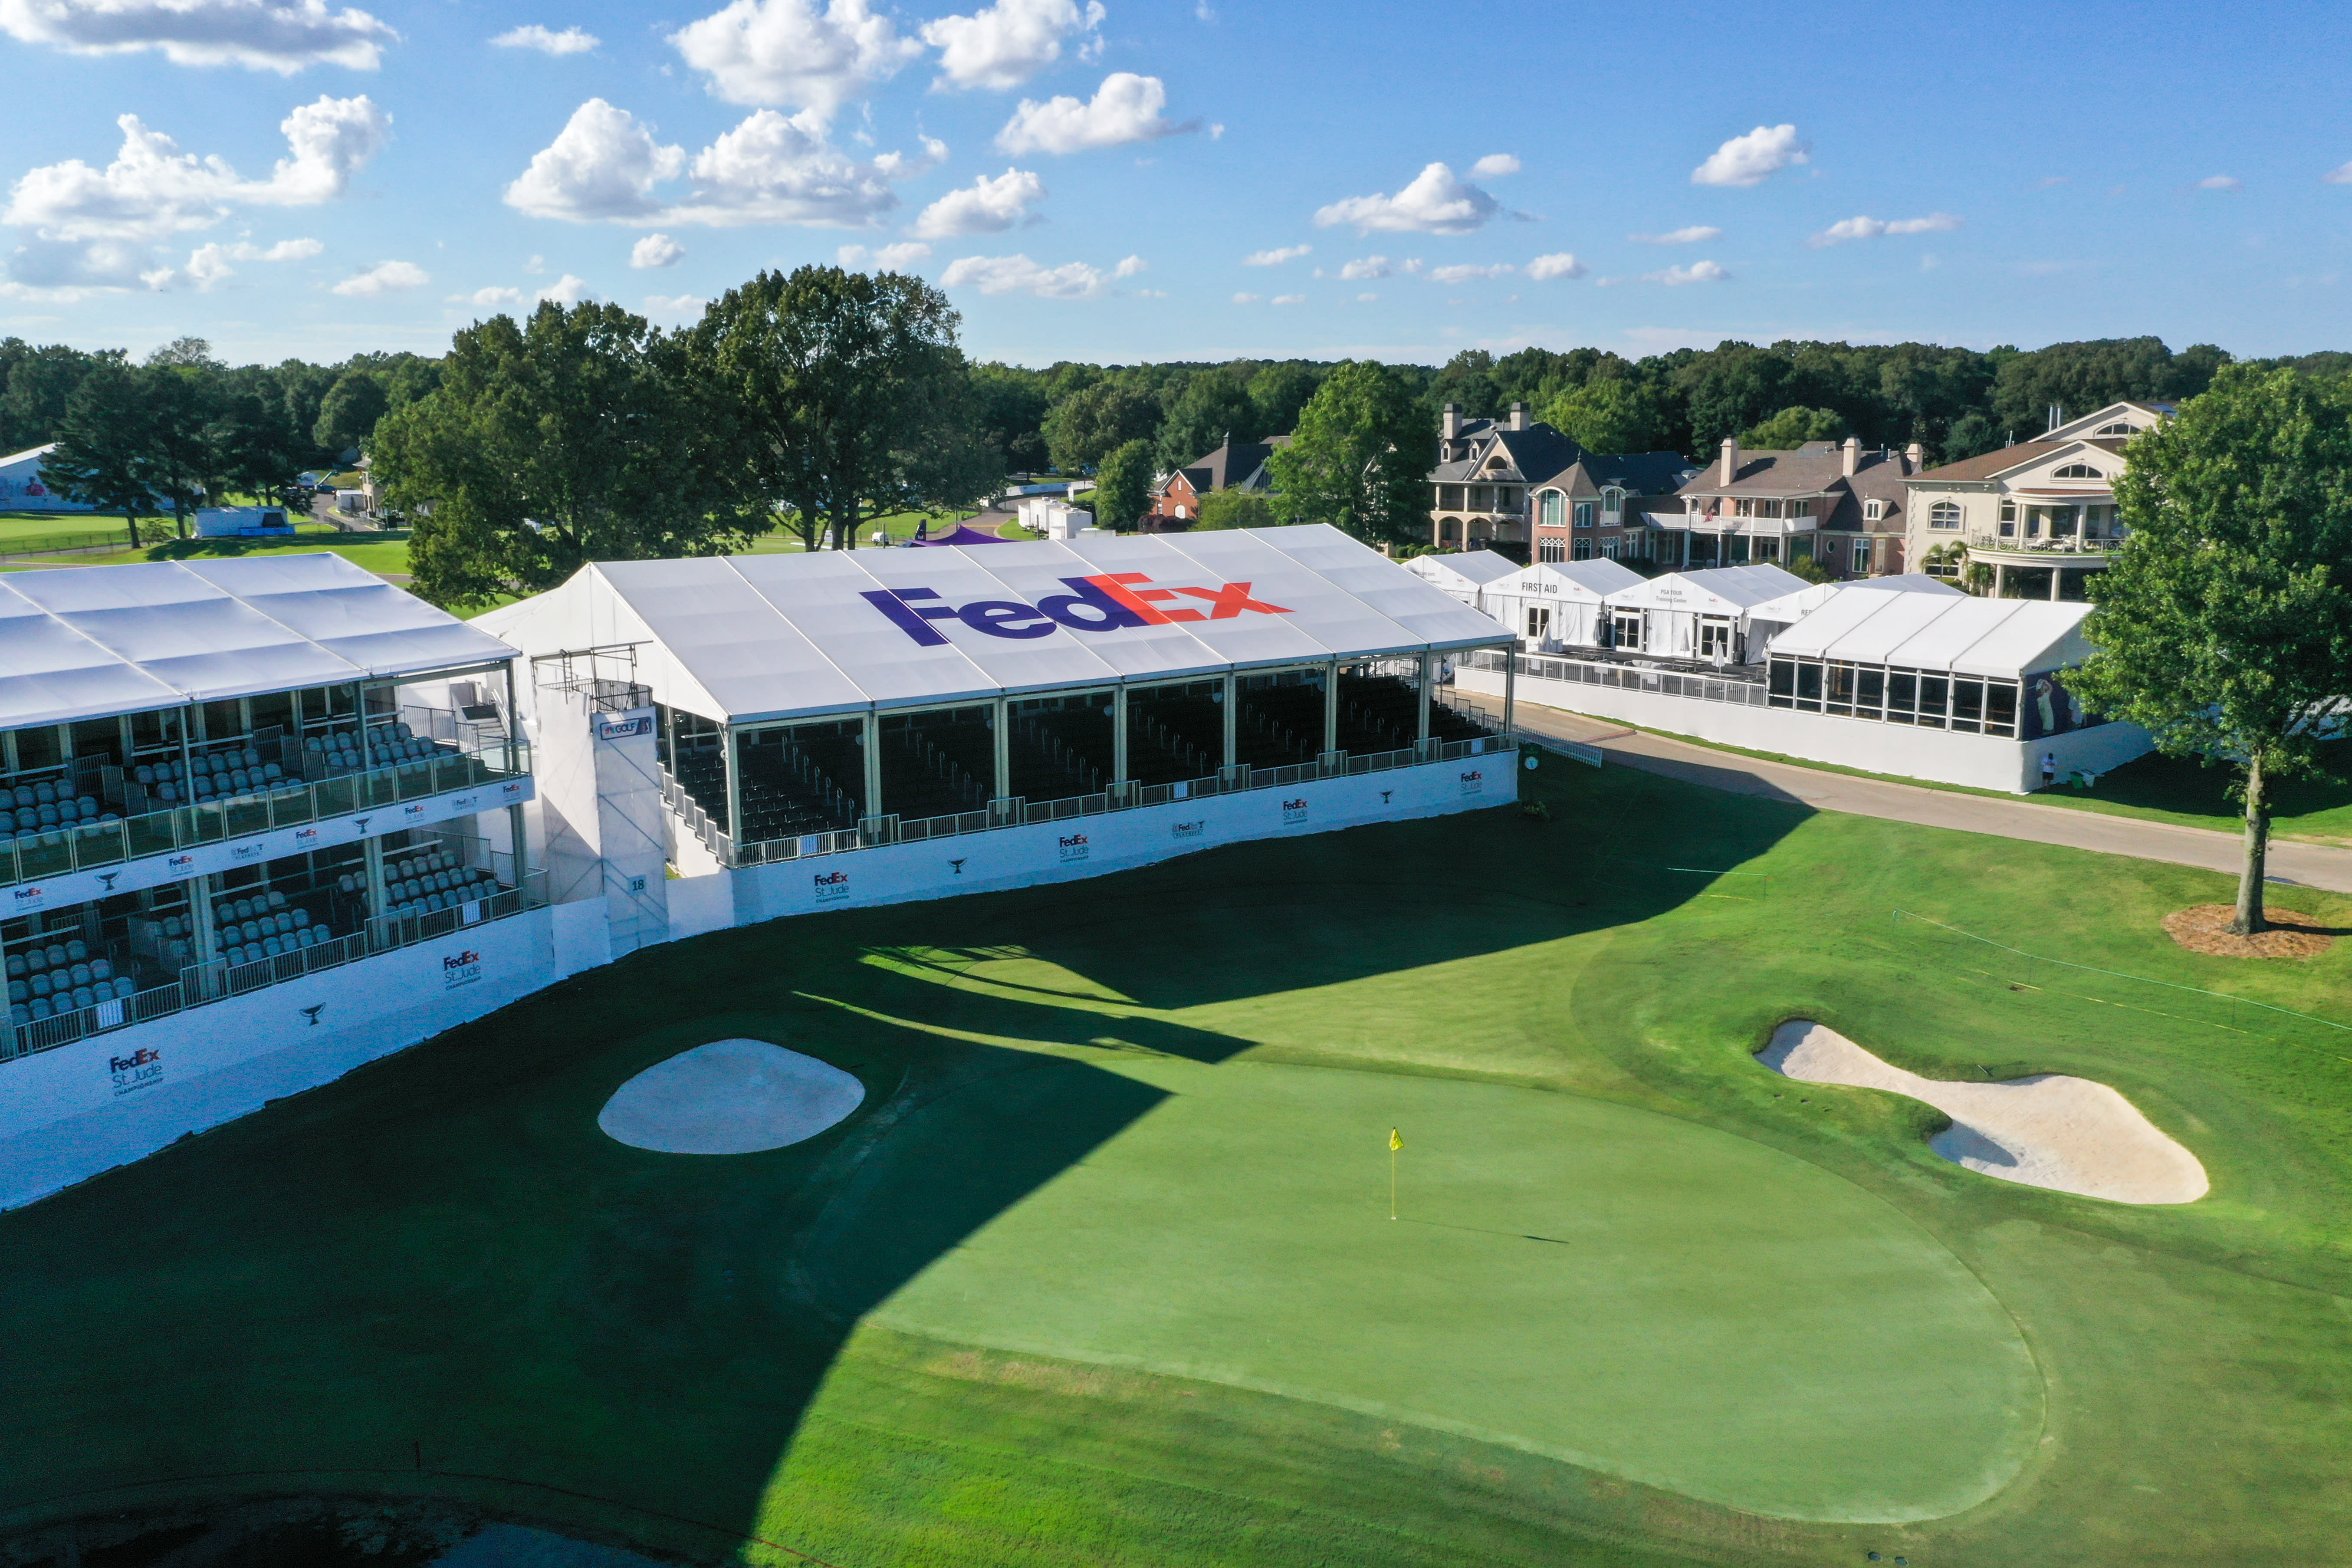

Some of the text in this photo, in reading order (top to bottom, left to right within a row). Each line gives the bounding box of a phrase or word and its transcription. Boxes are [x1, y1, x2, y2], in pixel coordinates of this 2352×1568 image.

[1522, 582, 1557, 593] FIRST AID
[858, 572, 1297, 647] FedEx
[615, 723, 635, 733] GOLF
[1461, 771, 1482, 782] FedEx
[405, 805, 424, 815] FedEx
[1283, 799, 1307, 811] FedEx
[296, 828, 317, 839] FedEx
[1059, 834, 1088, 848] FedEx
[169, 855, 192, 867] FedEx
[632, 879, 644, 891] 18
[814, 871, 848, 887] FedEx
[14, 888, 42, 900] FedEx
[827, 884, 849, 896] Jude
[443, 950, 480, 971] FedEx
[458, 964, 480, 980] Jude
[110, 1048, 161, 1074] FedEx
[131, 1063, 163, 1083] Jude
